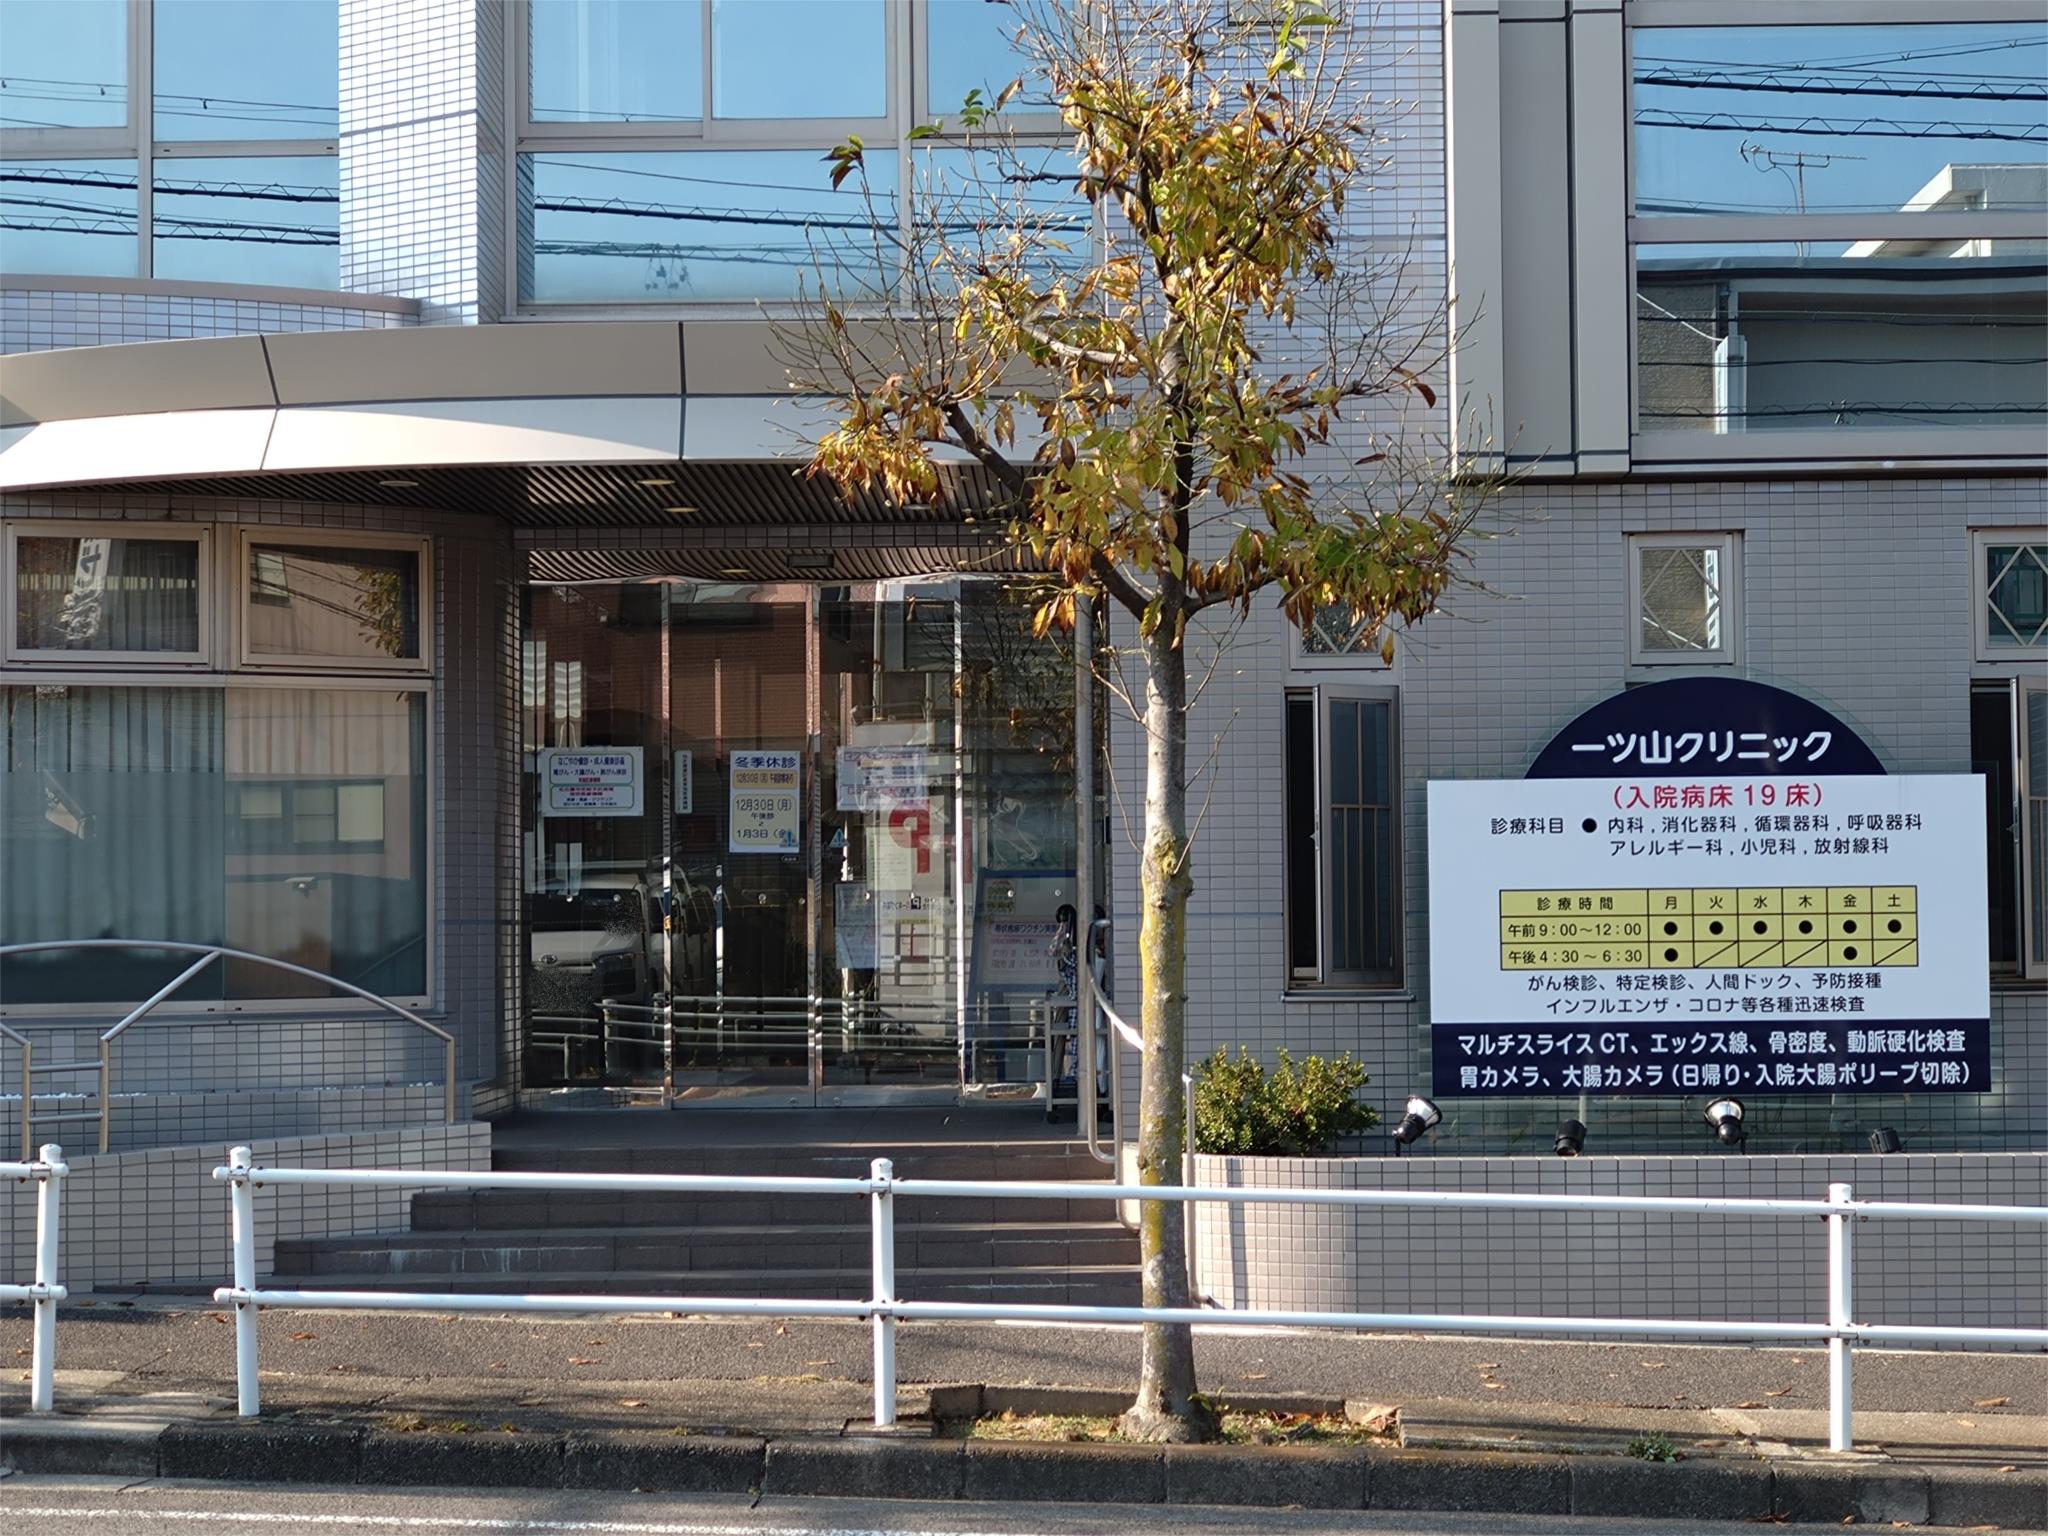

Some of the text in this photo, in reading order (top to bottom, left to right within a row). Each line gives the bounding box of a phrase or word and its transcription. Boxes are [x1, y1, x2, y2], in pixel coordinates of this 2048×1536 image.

[1570, 728, 1833, 765] 一ツ山クリニック
[735, 756, 797, 769] 冬季休診
[735, 798, 793, 812] 12月30日（月）
[1613, 782, 1823, 810] （入院病床19床）
[1491, 817, 1565, 835] 診療科目
[1536, 893, 1902, 911] 診療時間 月 火 水 木 金 土
[1527, 972, 1882, 992] がん検診、特定検診、人間ドック、予防接種
[1546, 995, 1865, 1015] インフルエンザ・コロナ等各種迅速検査
[1458, 1029, 1966, 1056] マルチスライスCT、エックス線、骨密度、動脈硬化検査
[1460, 1061, 1971, 1089] 胃カメラ、大腸カメラ（日帰り・入院大腸ポリープ切除）
